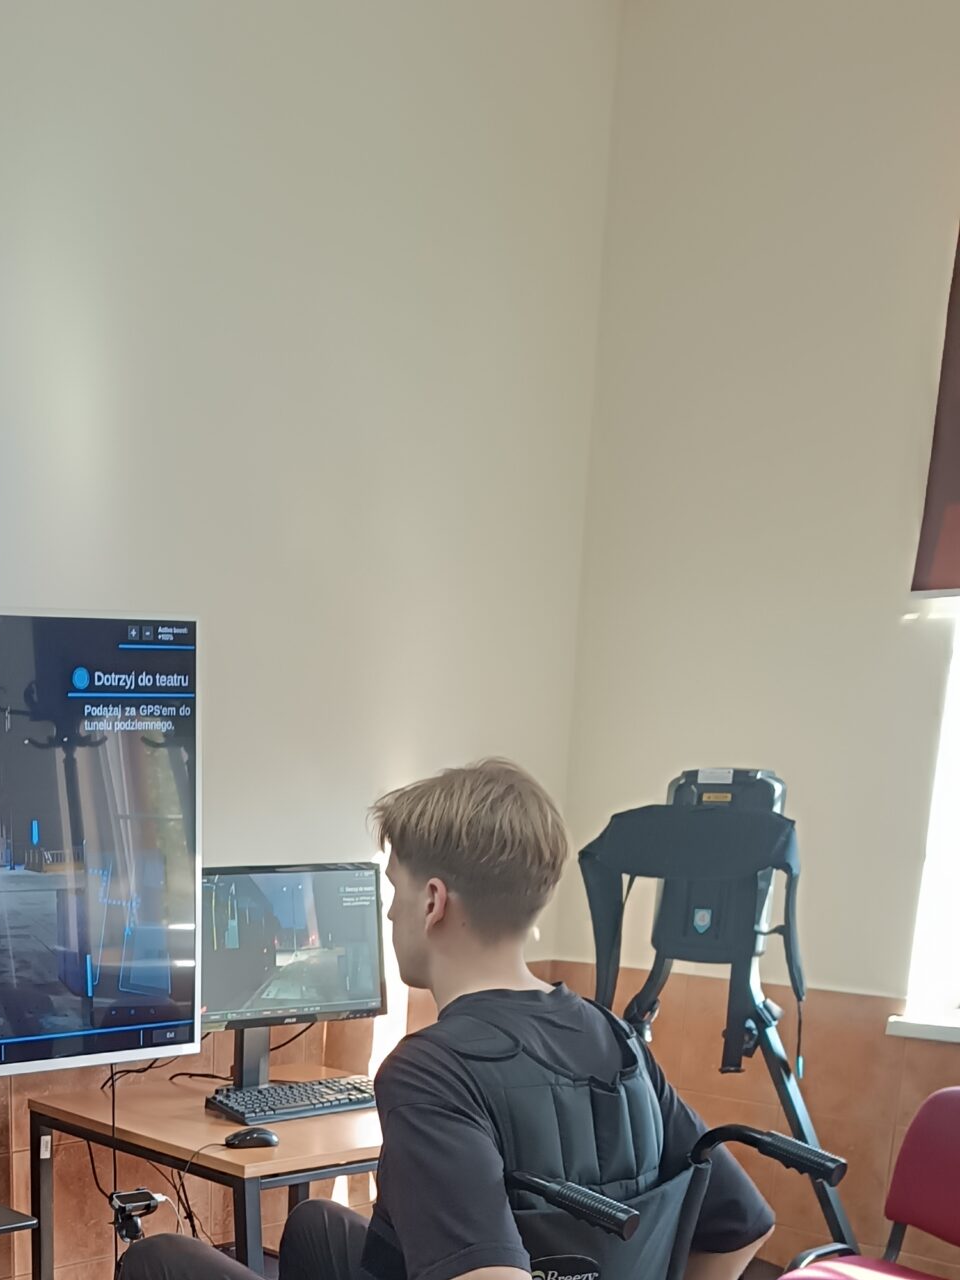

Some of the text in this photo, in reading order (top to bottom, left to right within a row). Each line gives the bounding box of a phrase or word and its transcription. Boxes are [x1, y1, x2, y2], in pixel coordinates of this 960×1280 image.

[94, 671, 189, 689] Dotrzyj do teatru
[84, 704, 121, 718] Podążaj
[125, 707, 136, 716] za
[179, 704, 191, 716] do
[84, 719, 175, 732] tunelu podziemnego.
